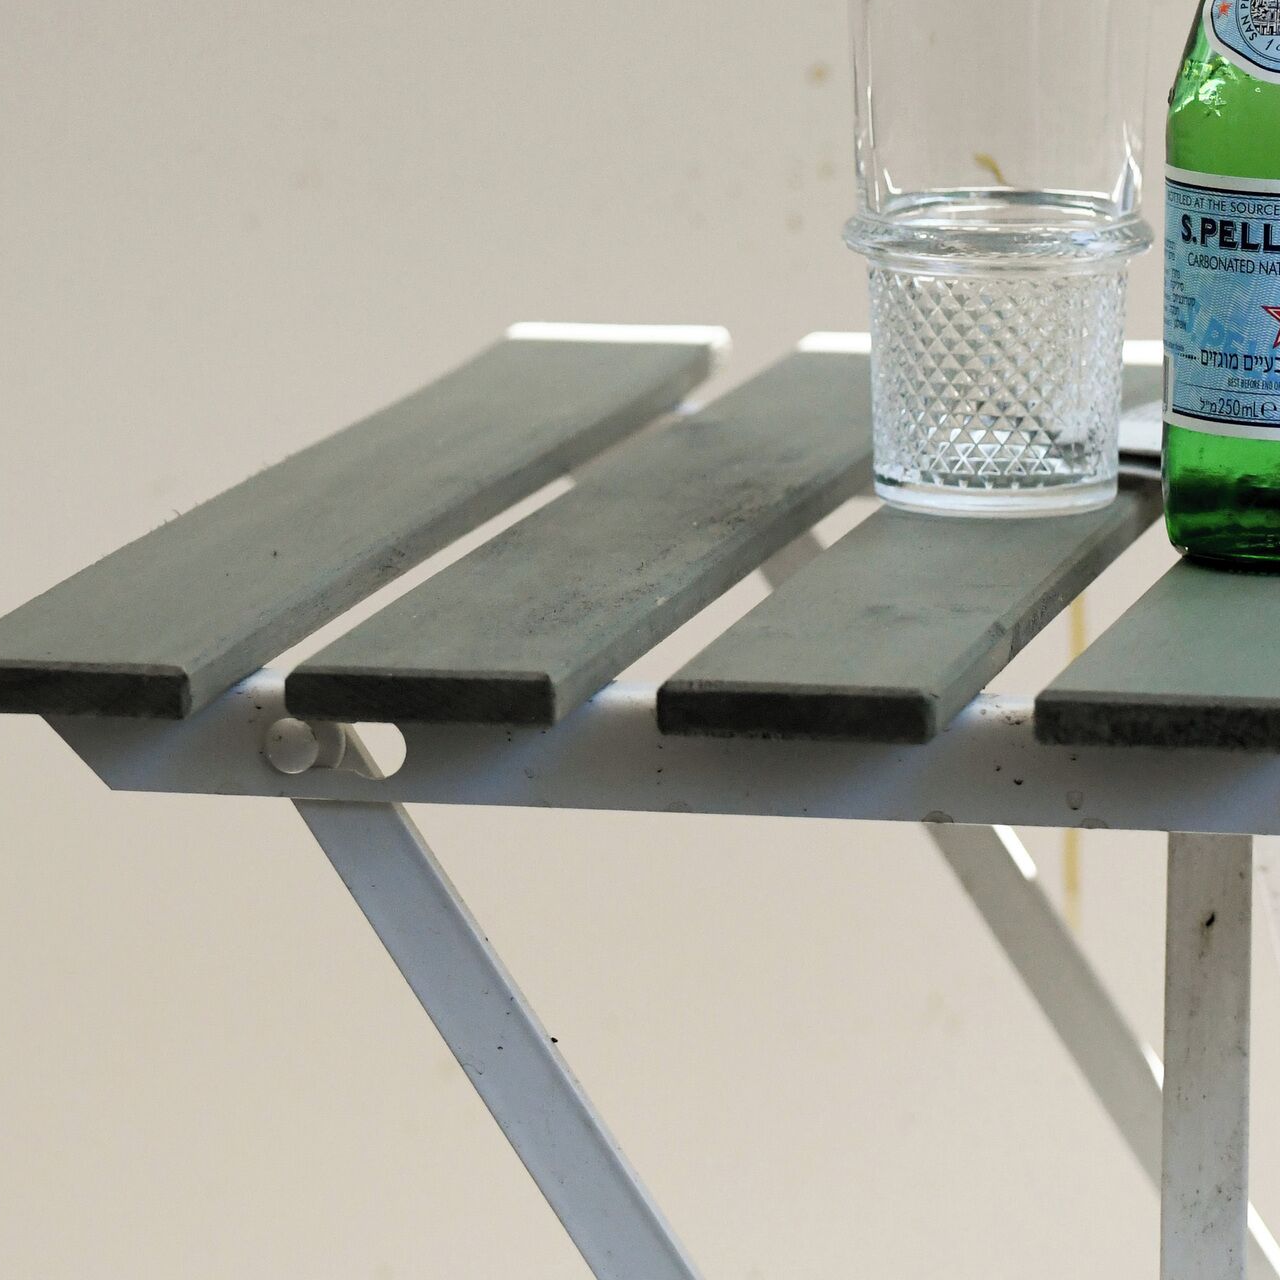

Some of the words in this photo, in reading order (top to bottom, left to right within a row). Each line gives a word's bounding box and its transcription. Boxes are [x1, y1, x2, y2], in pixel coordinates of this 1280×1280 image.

[1241, 15, 1258, 41] SAN
[1194, 198, 1205, 209] AT
[1208, 199, 1227, 212] THE
[1188, 252, 1255, 274] CARBONATED
[1201, 349, 1239, 370] מוגזים
[1227, 377, 1240, 388] BEST
[1241, 378, 1261, 389] BEFORE
